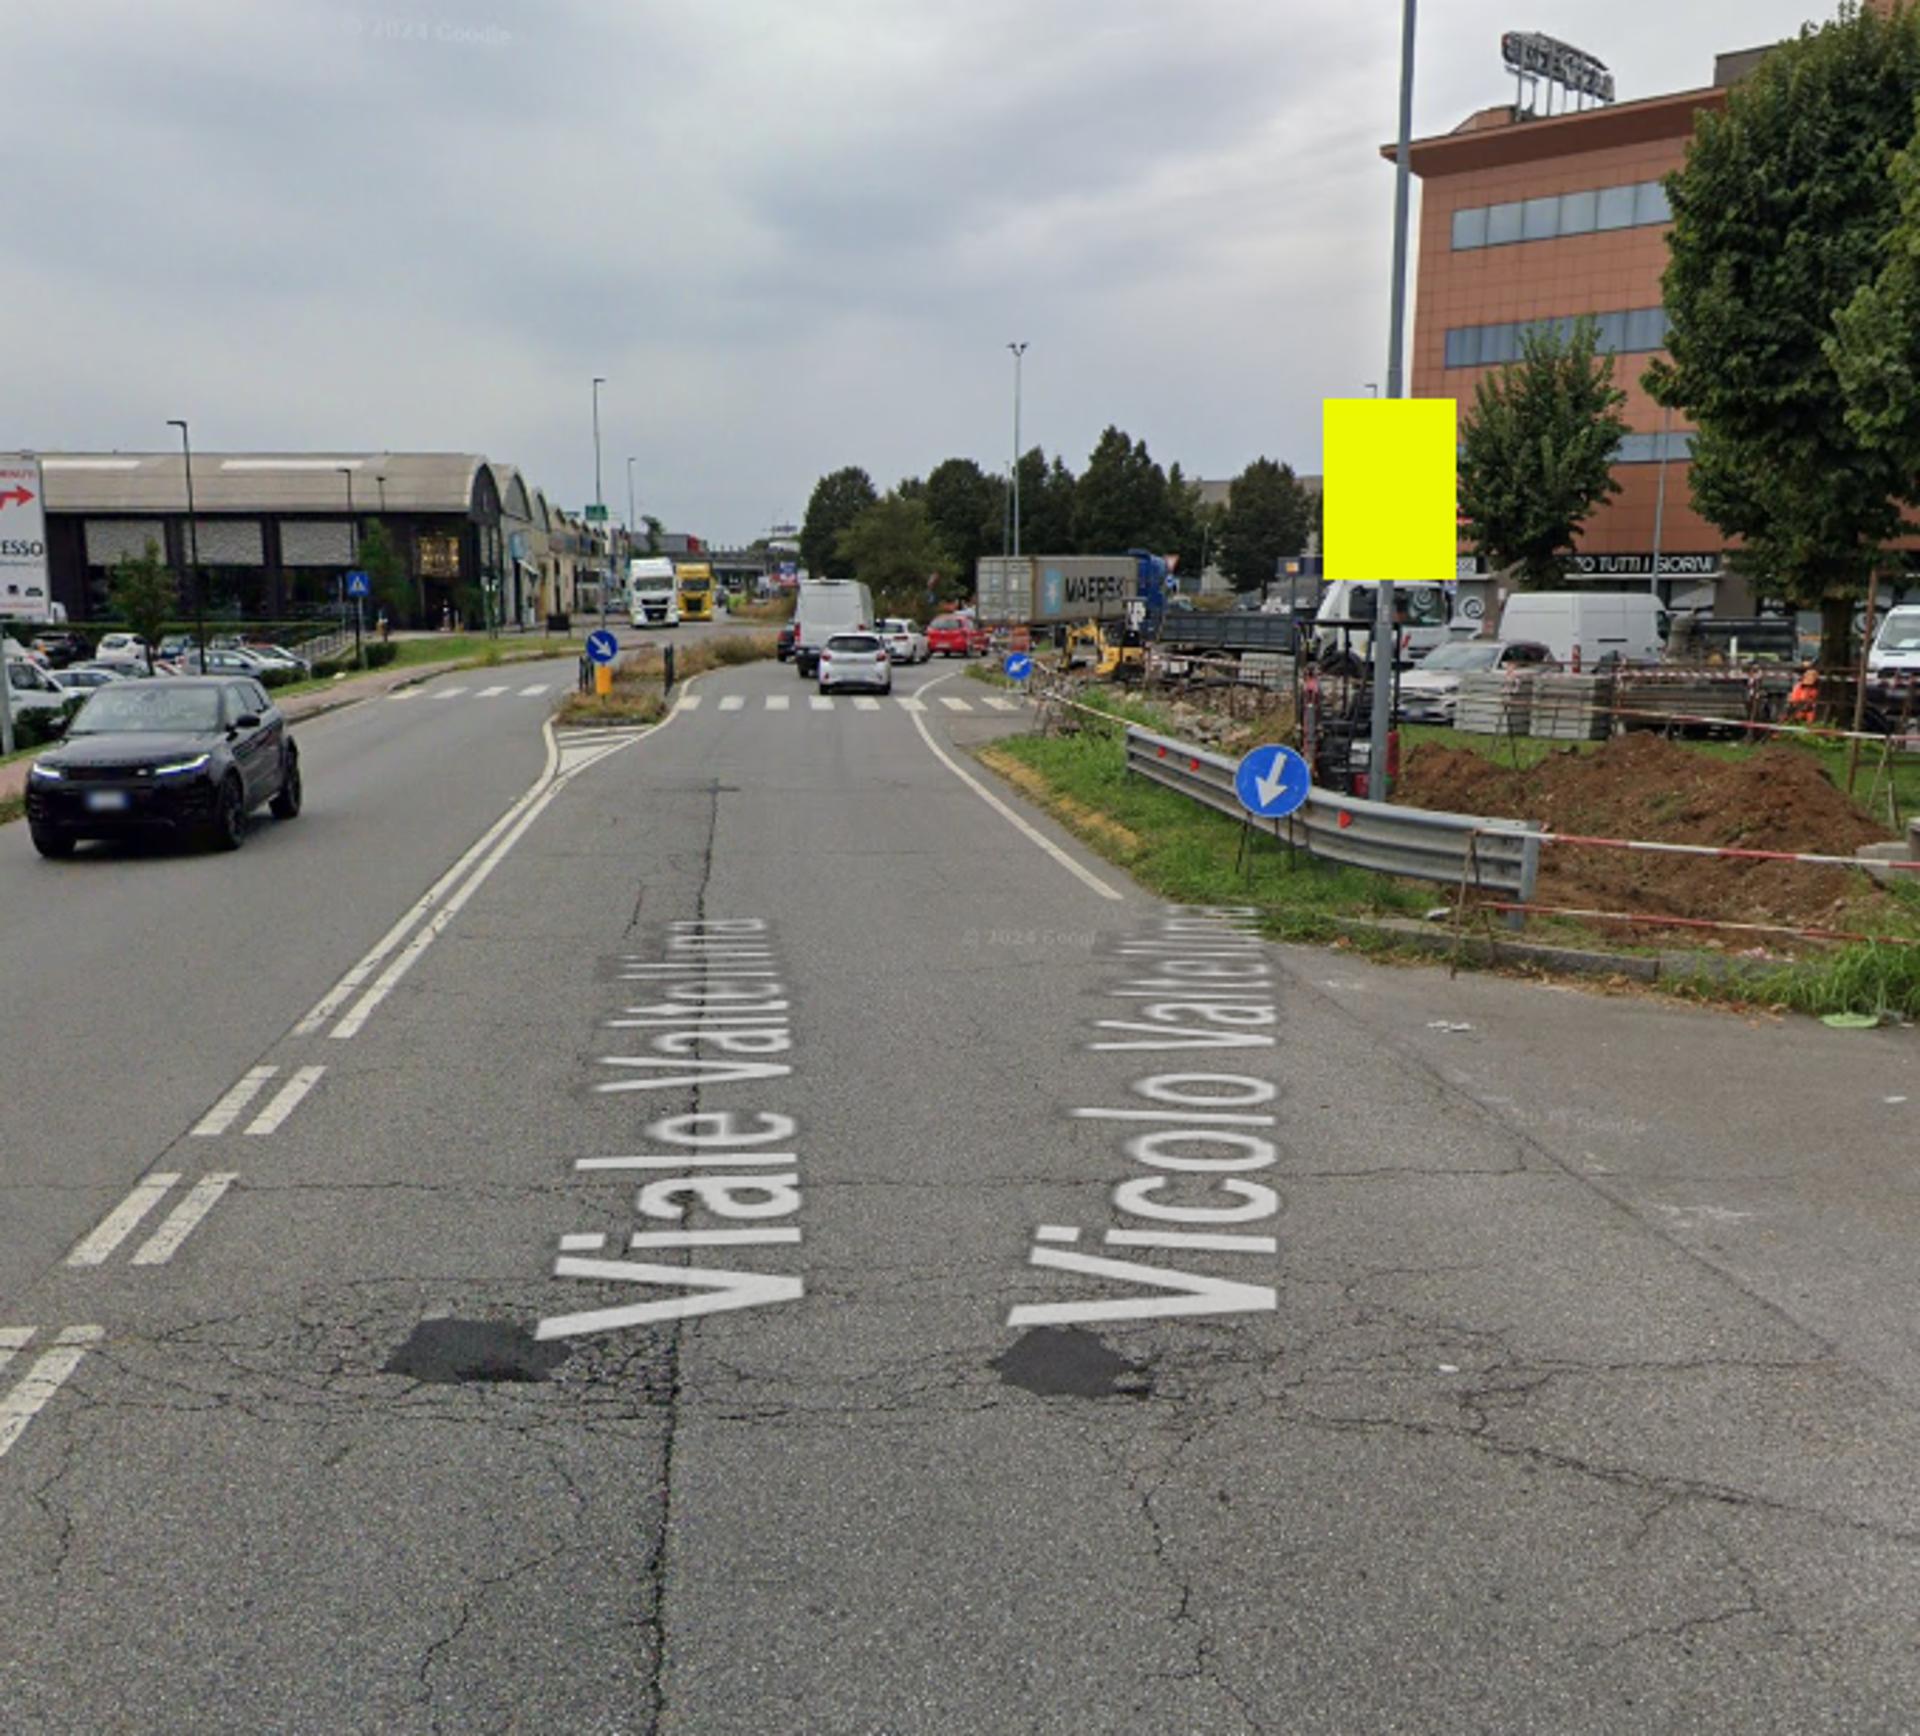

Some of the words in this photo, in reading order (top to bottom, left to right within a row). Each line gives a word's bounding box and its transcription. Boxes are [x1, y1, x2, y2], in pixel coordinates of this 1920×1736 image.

[1599, 556, 1641, 572] TUTTI
[1643, 556, 1650, 572] I
[1658, 556, 1716, 572] GIORNI
